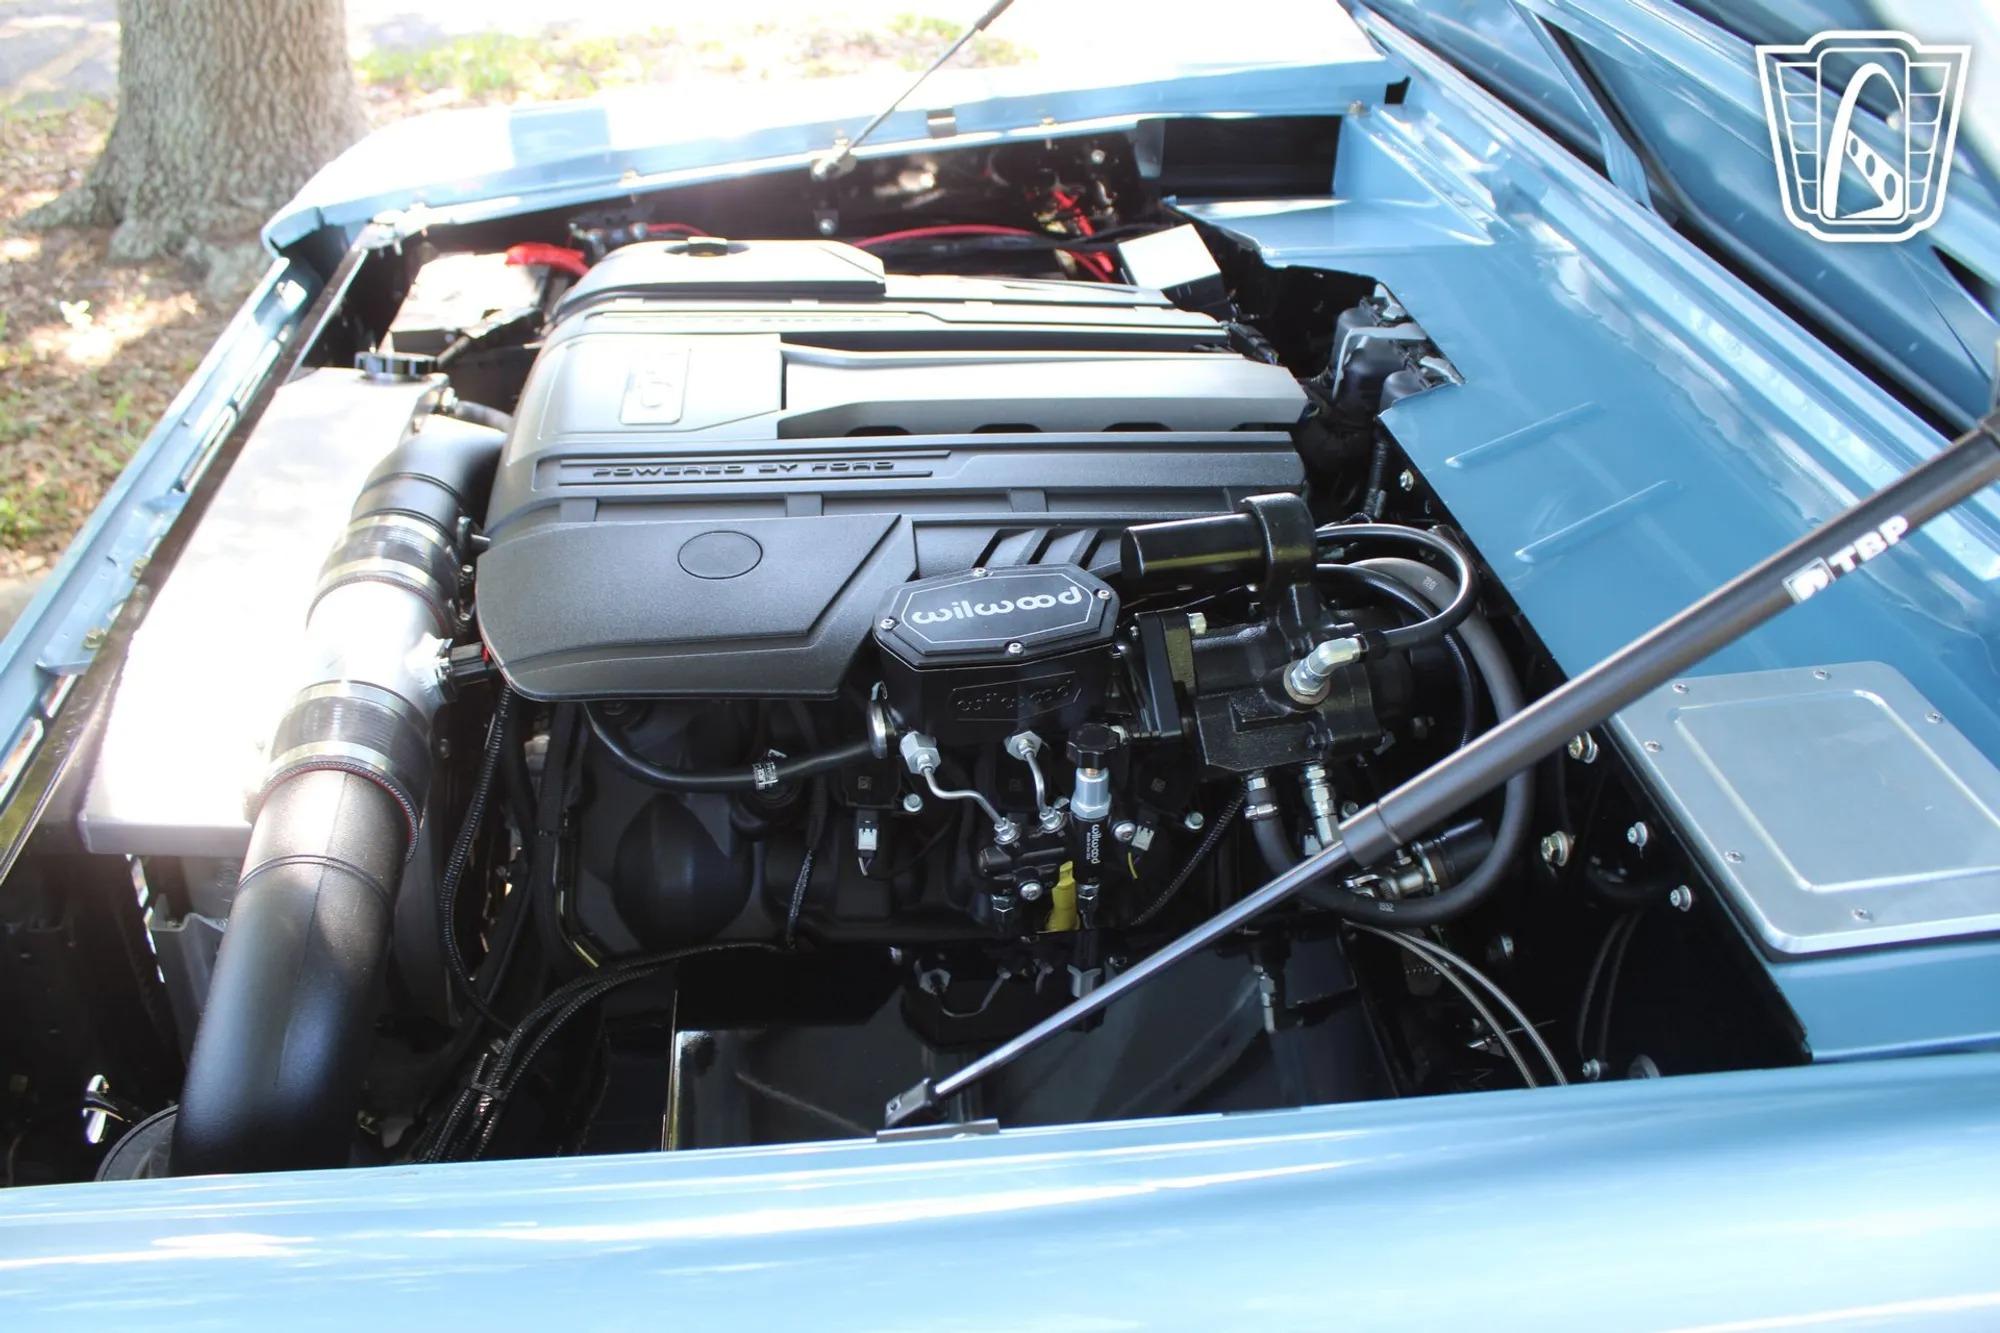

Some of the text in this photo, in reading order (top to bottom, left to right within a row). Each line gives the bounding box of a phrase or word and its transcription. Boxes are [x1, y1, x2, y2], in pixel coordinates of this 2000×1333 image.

[592, 460, 894, 478] POWERED BY FORD
[911, 586, 1083, 625] wilwood
[1090, 823, 1102, 865] wilwood
